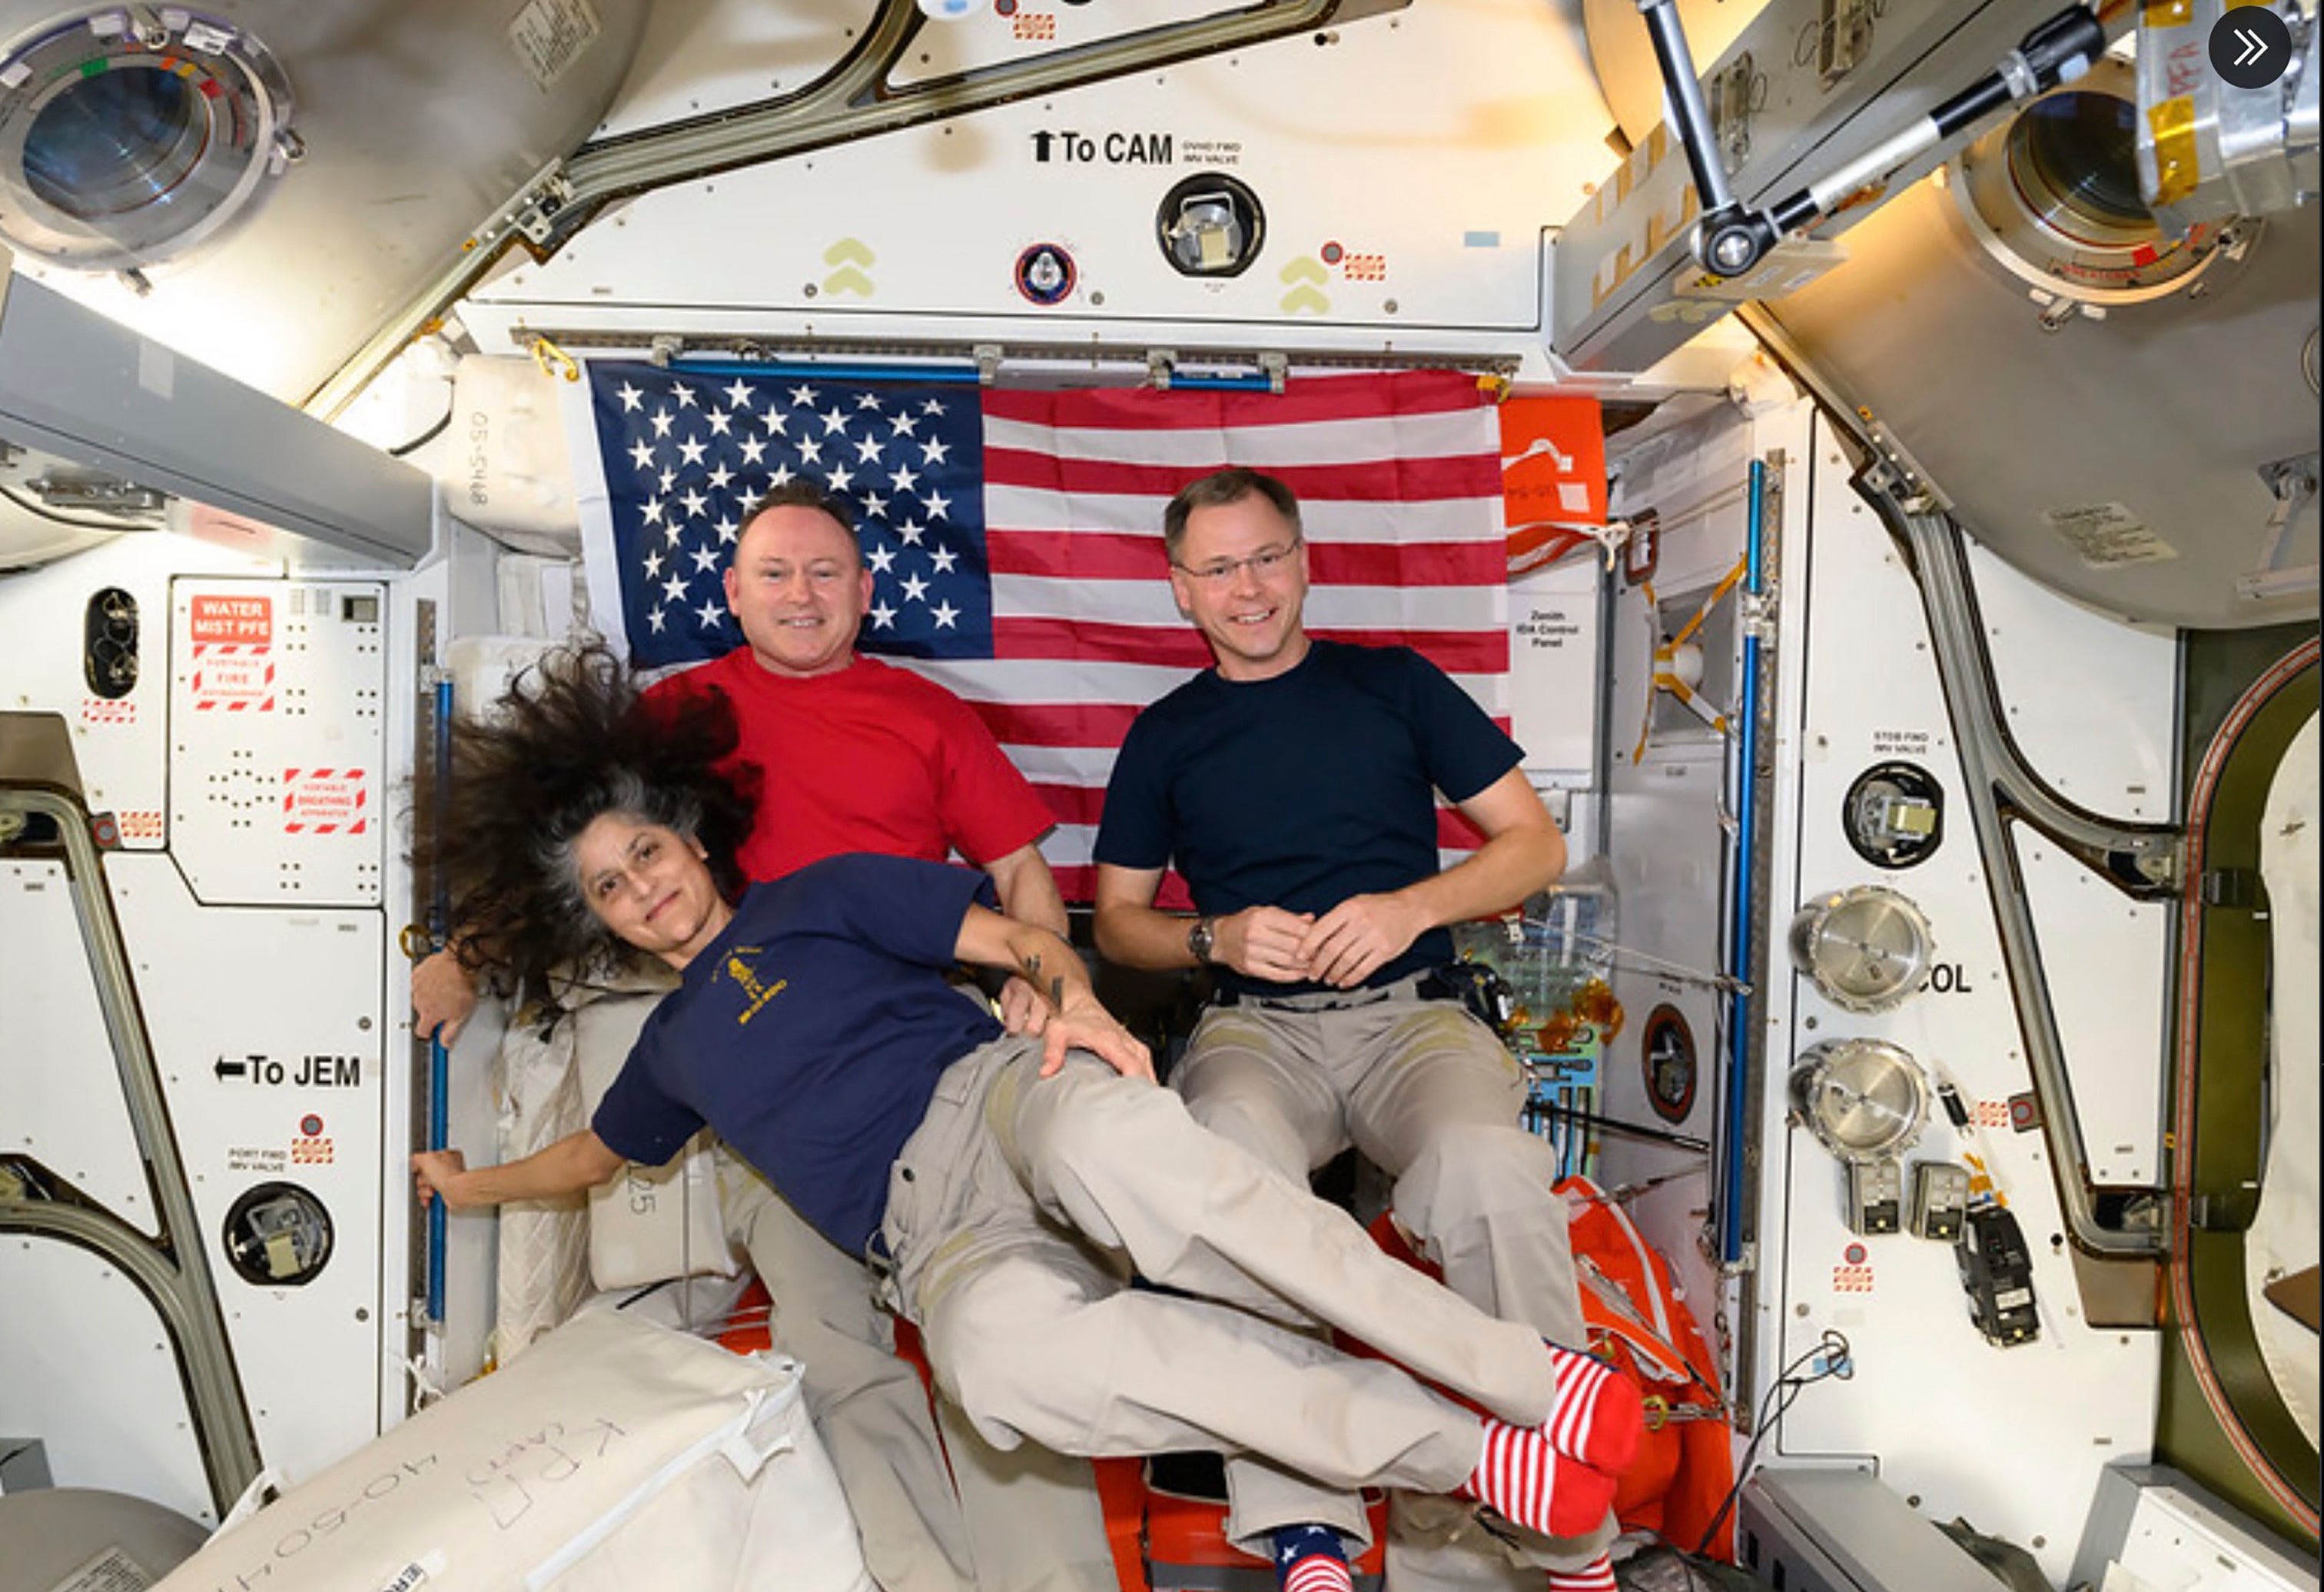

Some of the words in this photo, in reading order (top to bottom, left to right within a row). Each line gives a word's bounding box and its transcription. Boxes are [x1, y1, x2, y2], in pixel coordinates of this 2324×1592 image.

[1060, 131, 1096, 162] To
[1104, 132, 1174, 165] CAM
[202, 601, 263, 618] WATER
[1530, 610, 1565, 621] Zenith
[194, 619, 234, 635] MIST
[237, 620, 270, 636] PFE
[1537, 623, 1579, 636] Control
[1531, 637, 1563, 648] Panel
[217, 673, 249, 685] FIRE
[297, 795, 352, 807] BREATHING
[1919, 963, 1972, 993] OL
[246, 1054, 285, 1085] To
[294, 1055, 360, 1088] JEM
[217, 1453, 437, 1592] 40-504
